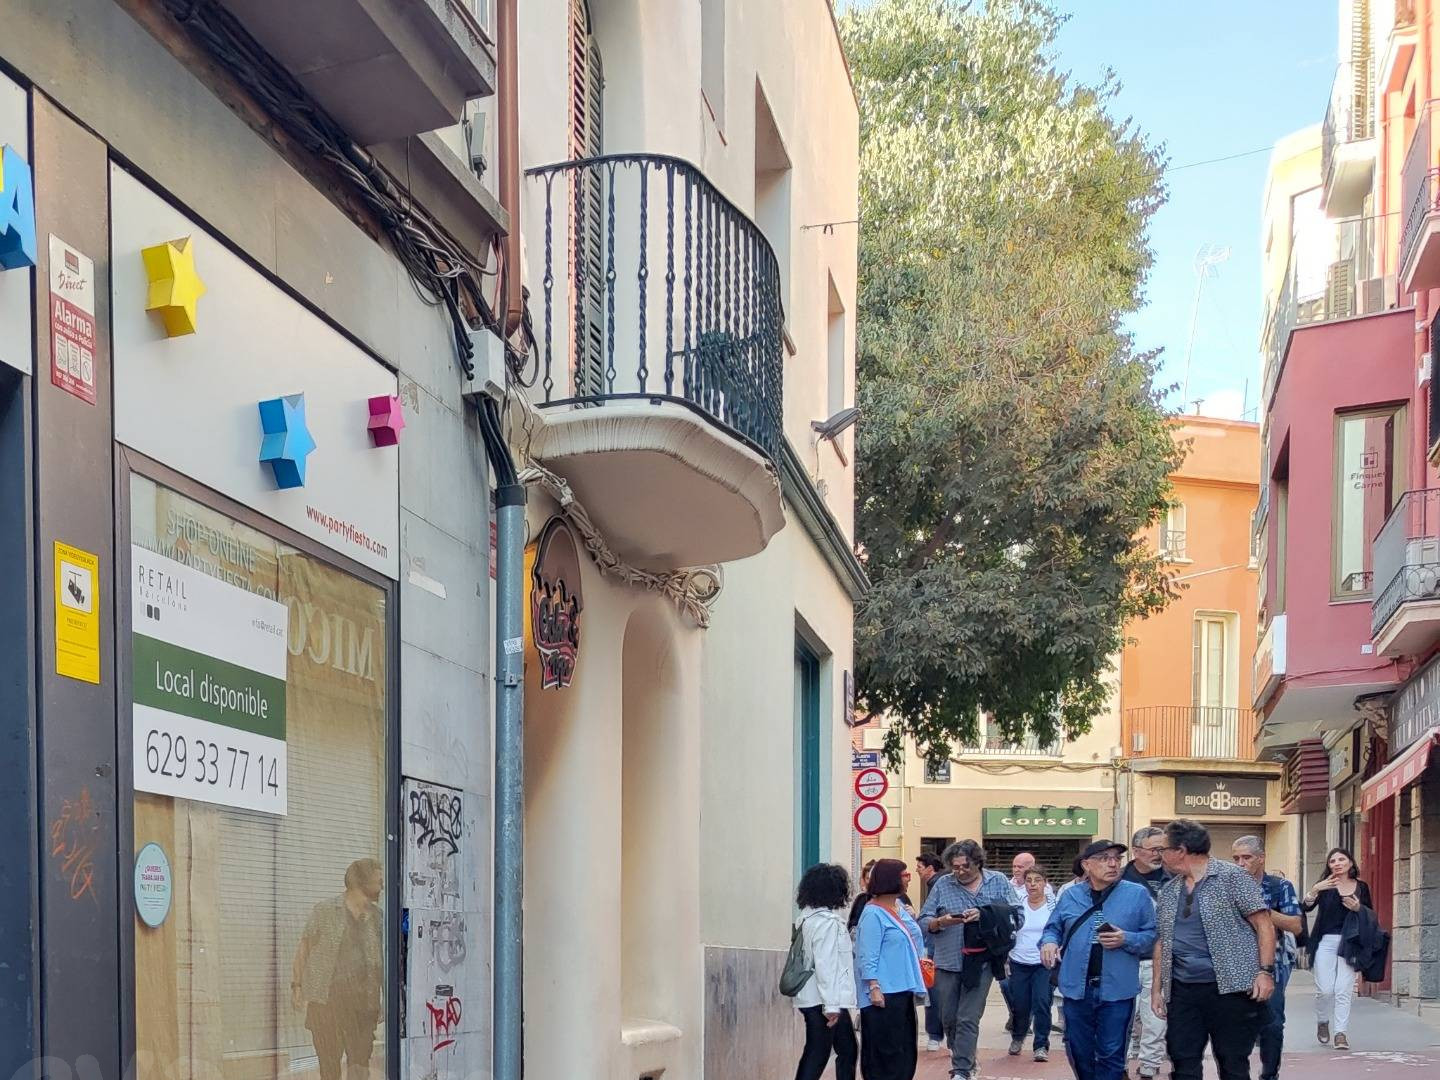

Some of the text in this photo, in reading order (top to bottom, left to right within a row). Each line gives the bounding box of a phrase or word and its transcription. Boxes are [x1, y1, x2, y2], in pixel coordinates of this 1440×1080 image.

[54, 300, 93, 338] Alarma
[166, 508, 258, 576] SHOP ONLINE
[306, 504, 388, 559] www.partyfiesta.com
[138, 564, 187, 600] RETAIL
[156, 660, 268, 719] Local disponible
[146, 729, 279, 797] 629 33 77 14
[1000, 815, 1087, 827] corset
[1184, 795, 1210, 808] BIJOU
